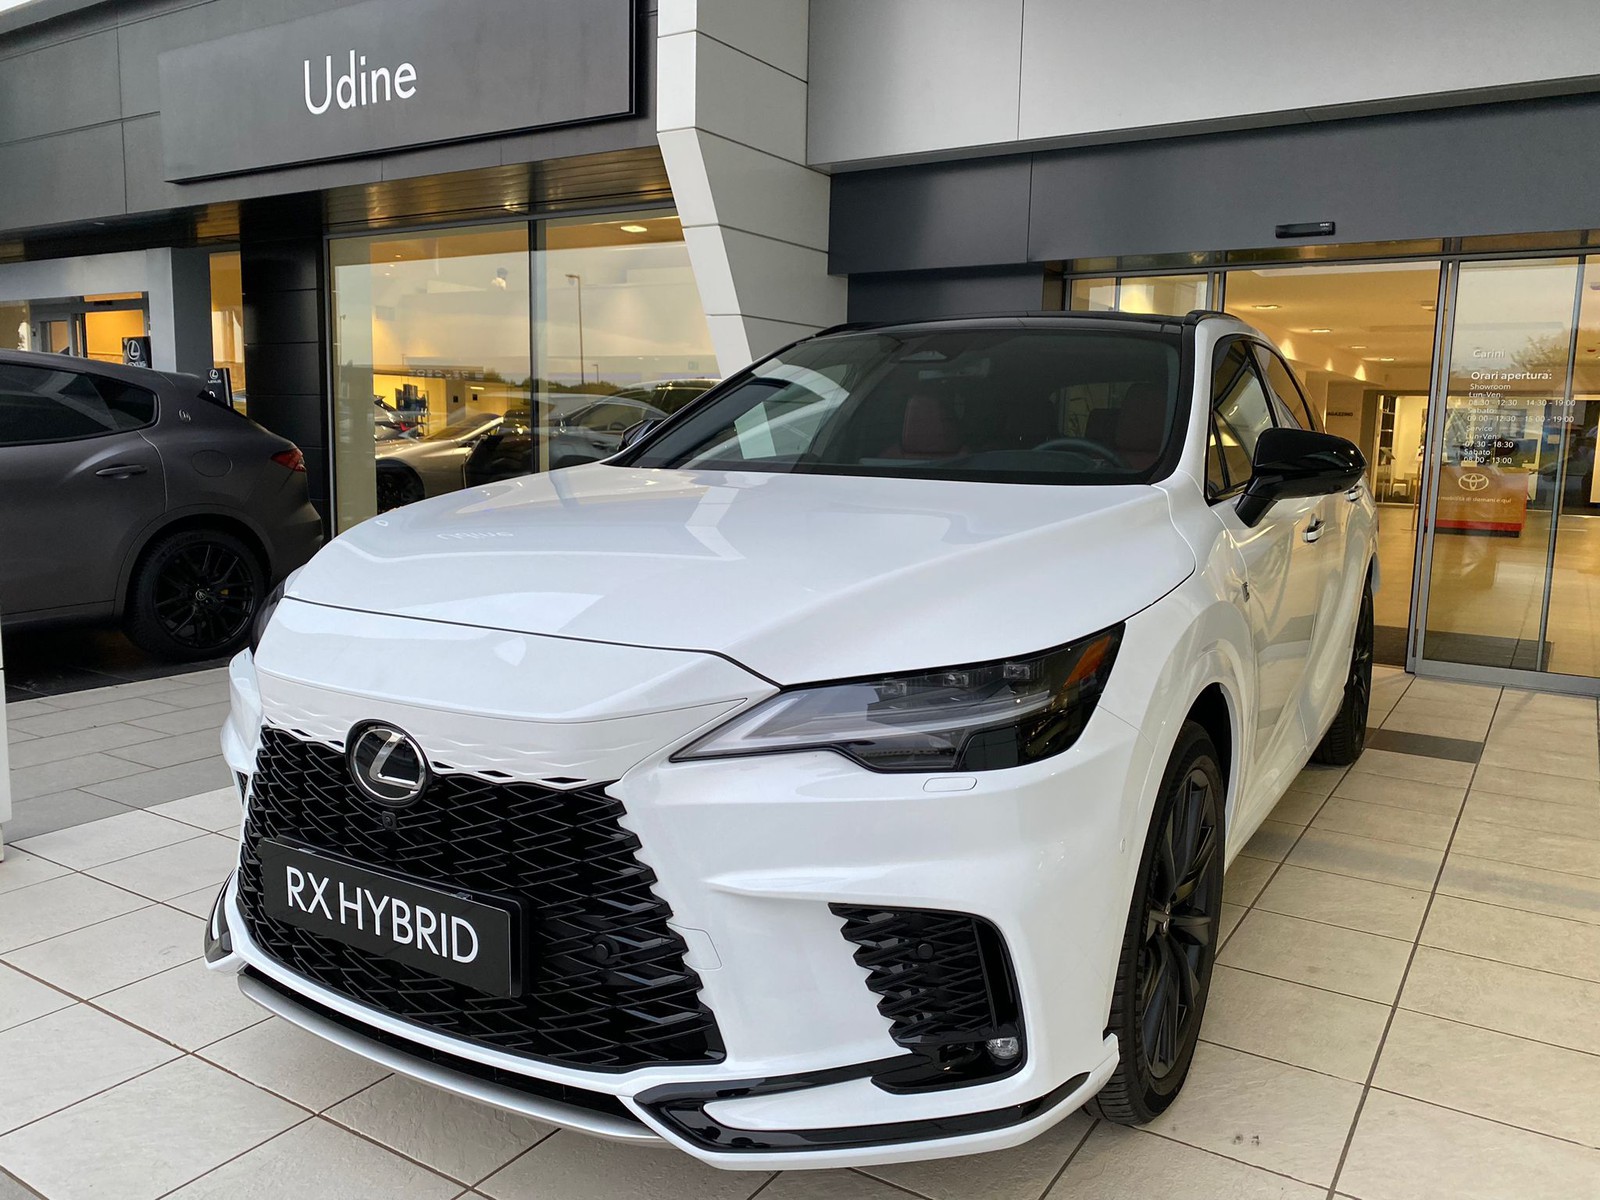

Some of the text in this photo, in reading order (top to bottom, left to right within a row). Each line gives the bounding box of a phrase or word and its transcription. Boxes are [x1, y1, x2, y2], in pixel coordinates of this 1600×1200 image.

[304, 49, 417, 115] Udine
[1473, 349, 1505, 358] Carini
[1471, 371, 1552, 382] Orari apertura:
[1526, 399, 1547, 407] 14:30
[1555, 399, 1576, 407] 19:00
[1553, 415, 1574, 423] 19:00
[286, 865, 479, 964] RX HYBRID
